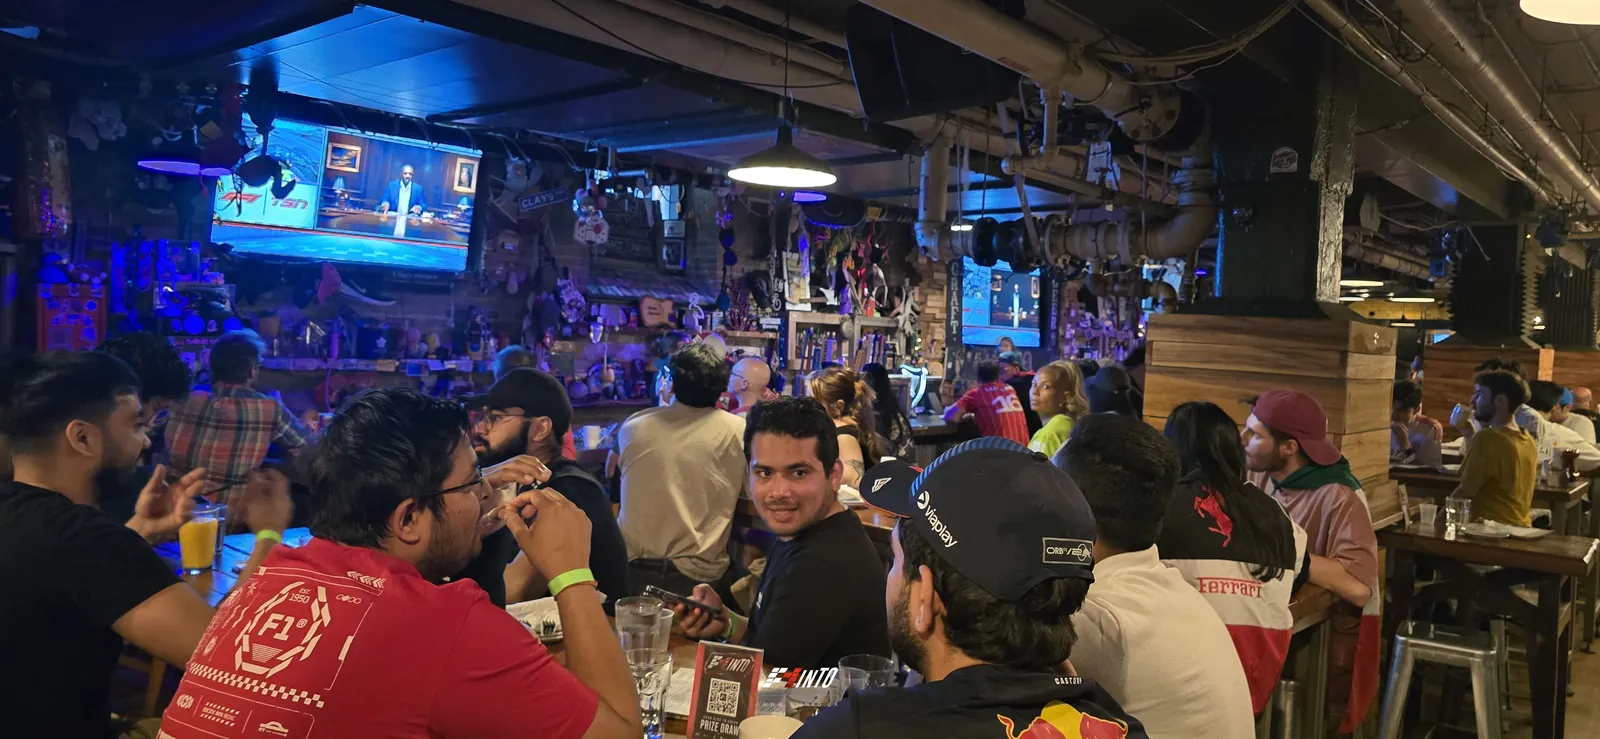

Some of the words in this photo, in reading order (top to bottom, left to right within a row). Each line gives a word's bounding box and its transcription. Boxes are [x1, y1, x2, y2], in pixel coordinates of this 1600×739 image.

[950, 261, 960, 335] CRAFT
[992, 394, 1024, 413] 16
[924, 504, 958, 547] viaplay
[1197, 576, 1264, 598] Ferrari
[288, 593, 310, 604] 1950
[700, 719, 719, 732] PRIZE
[719, 723, 740, 737] DRAW
